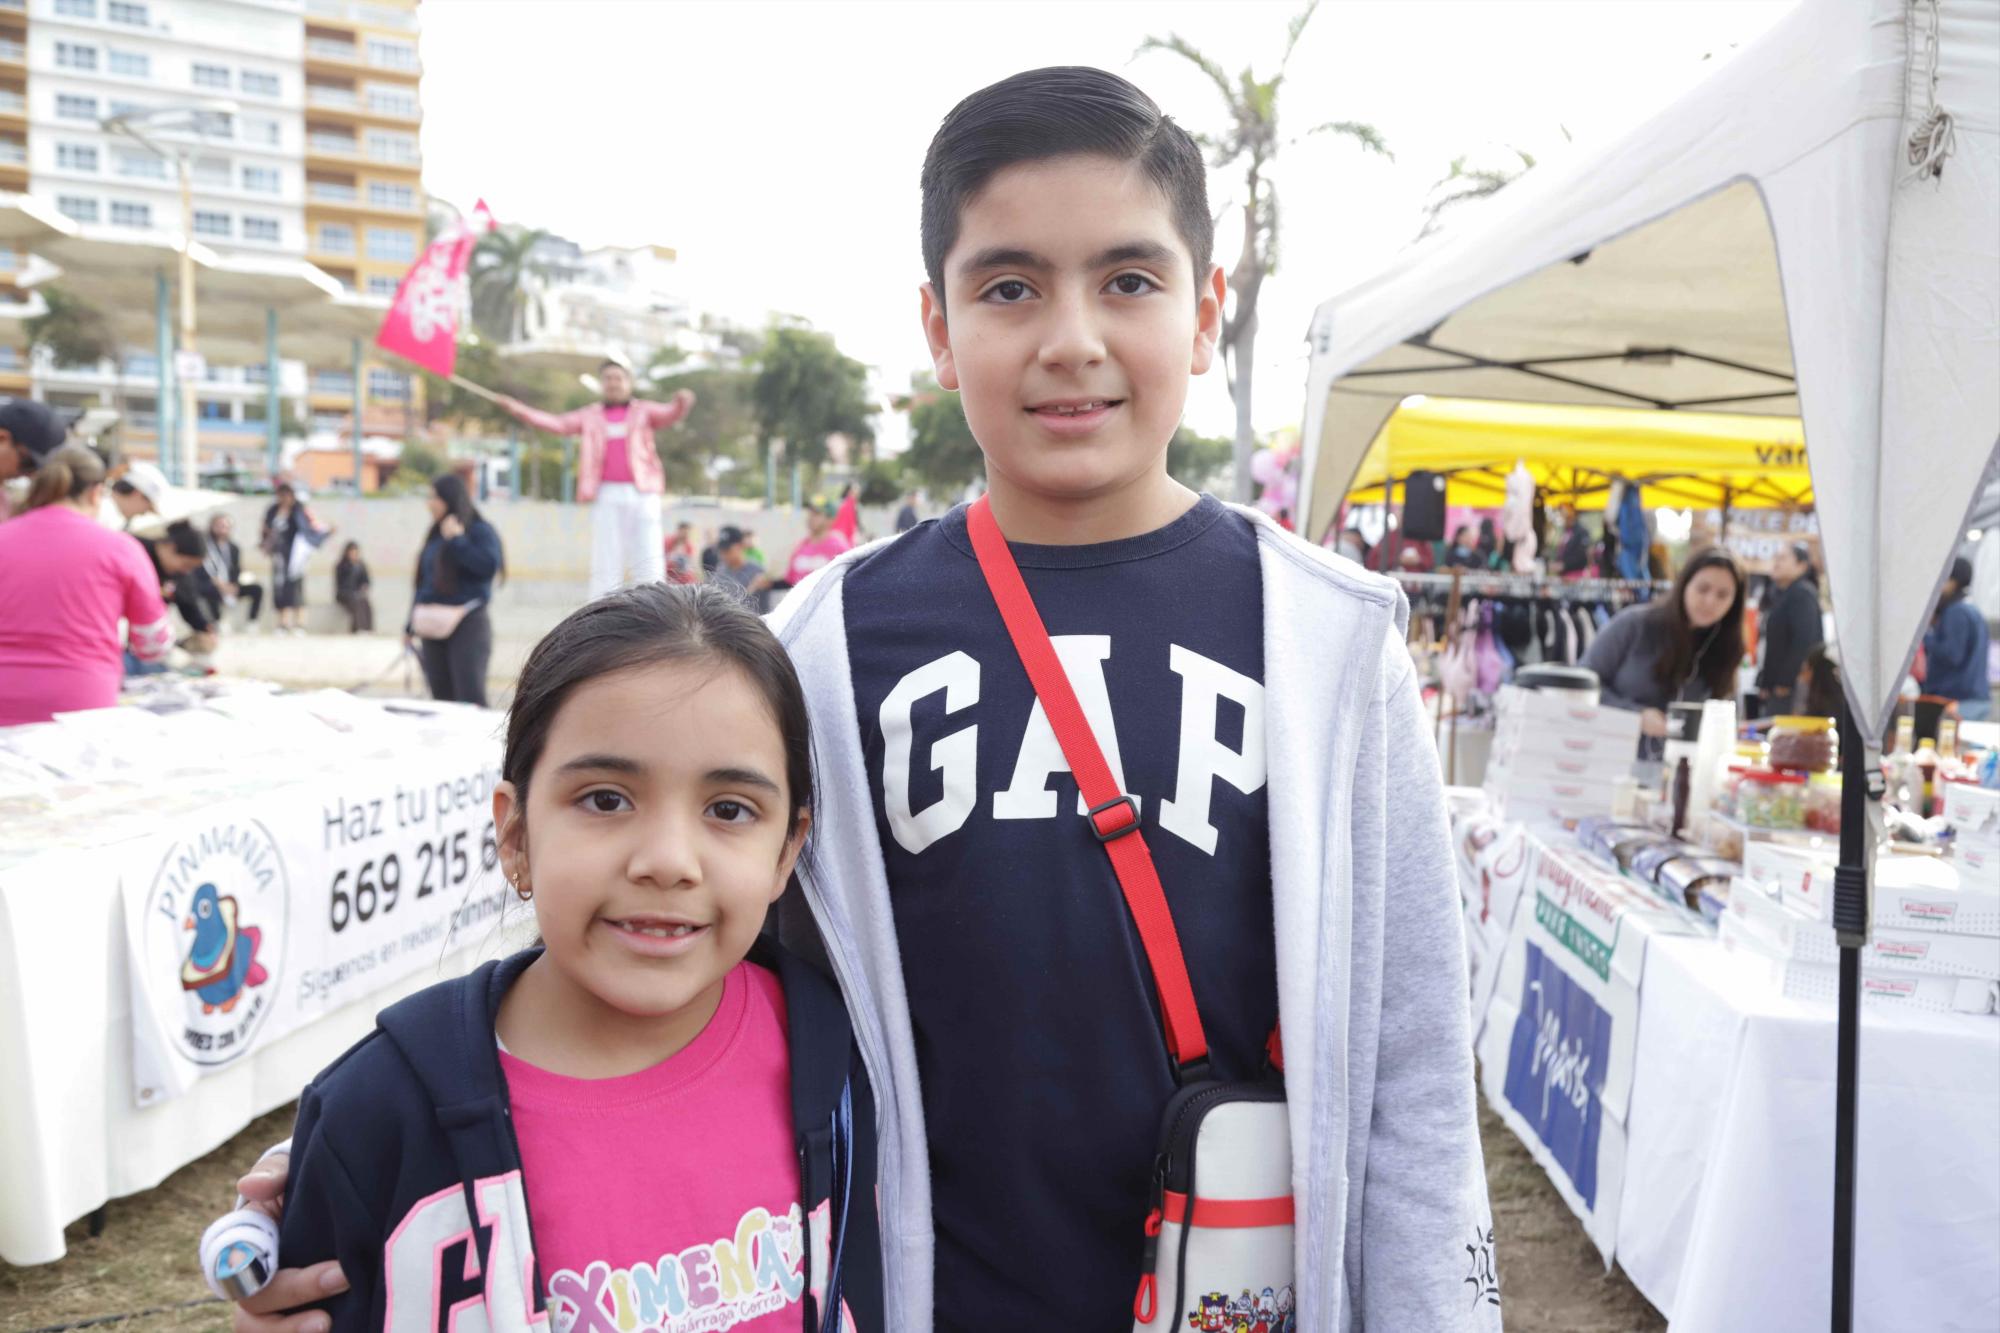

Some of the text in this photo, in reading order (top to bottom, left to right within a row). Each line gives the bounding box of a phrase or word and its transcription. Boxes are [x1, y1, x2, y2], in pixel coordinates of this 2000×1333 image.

[879, 634, 1267, 857] GAP
[323, 797, 384, 850] Haz
[395, 783, 427, 828] tu
[330, 852, 400, 934] 669
[416, 829, 468, 899] 215
[550, 1208, 804, 1333] XIMENA
[740, 1292, 783, 1317] Correa
